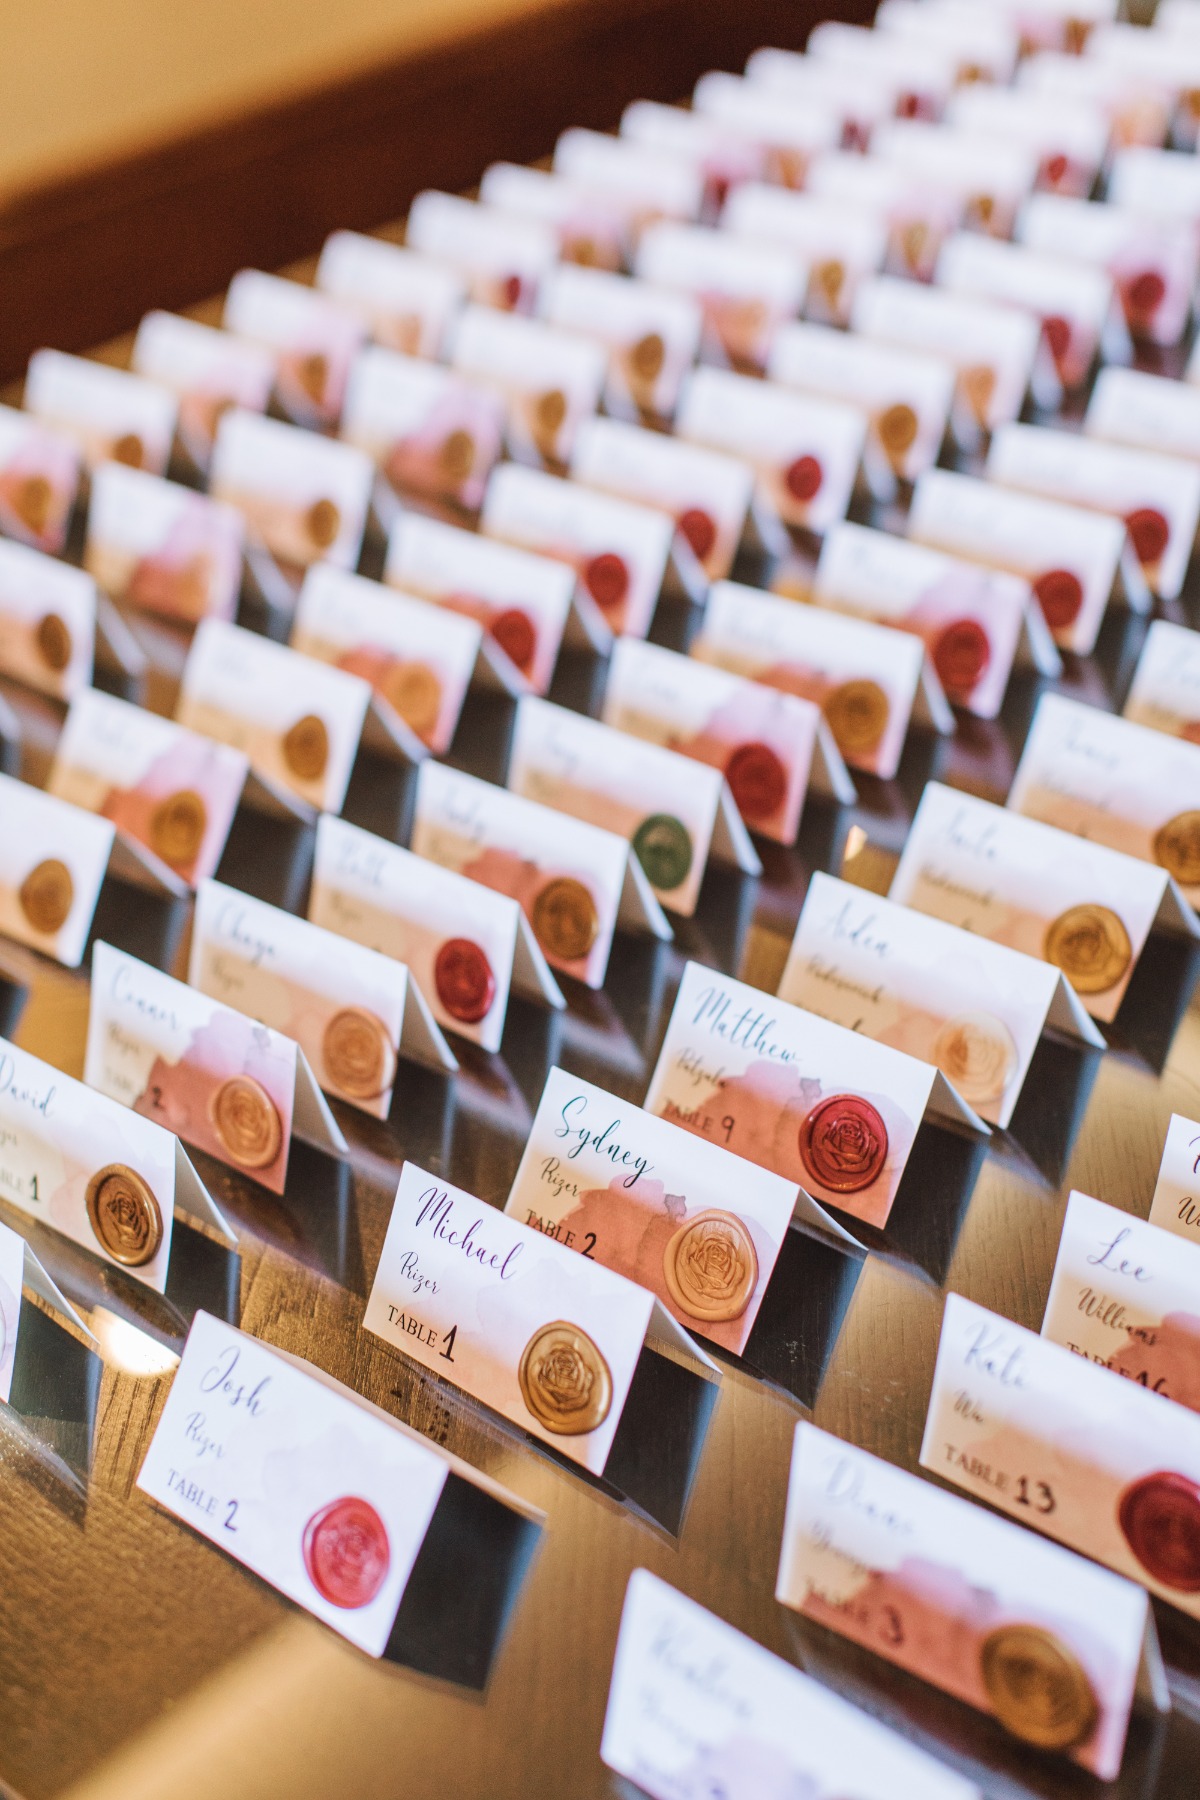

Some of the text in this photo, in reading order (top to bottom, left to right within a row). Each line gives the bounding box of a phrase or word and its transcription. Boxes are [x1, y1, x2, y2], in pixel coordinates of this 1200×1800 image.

[692, 986, 801, 1062] Matthew
[554, 1095, 655, 1189] Sydney
[722, 1114, 735, 1144] 9
[28, 1173, 40, 1202] 1
[540, 1156, 582, 1198] Rizer
[415, 1187, 526, 1280] Michael
[526, 1208, 598, 1260] TABLE 2
[1086, 1227, 1153, 1283] Lee
[400, 1251, 441, 1295] Rizer
[387, 1304, 459, 1364] TABLE 1
[1077, 1287, 1159, 1347] Williams
[200, 1345, 273, 1417] Josh
[166, 1467, 240, 1533] TABLE 2
[944, 1442, 1057, 1514] TABLE 13
